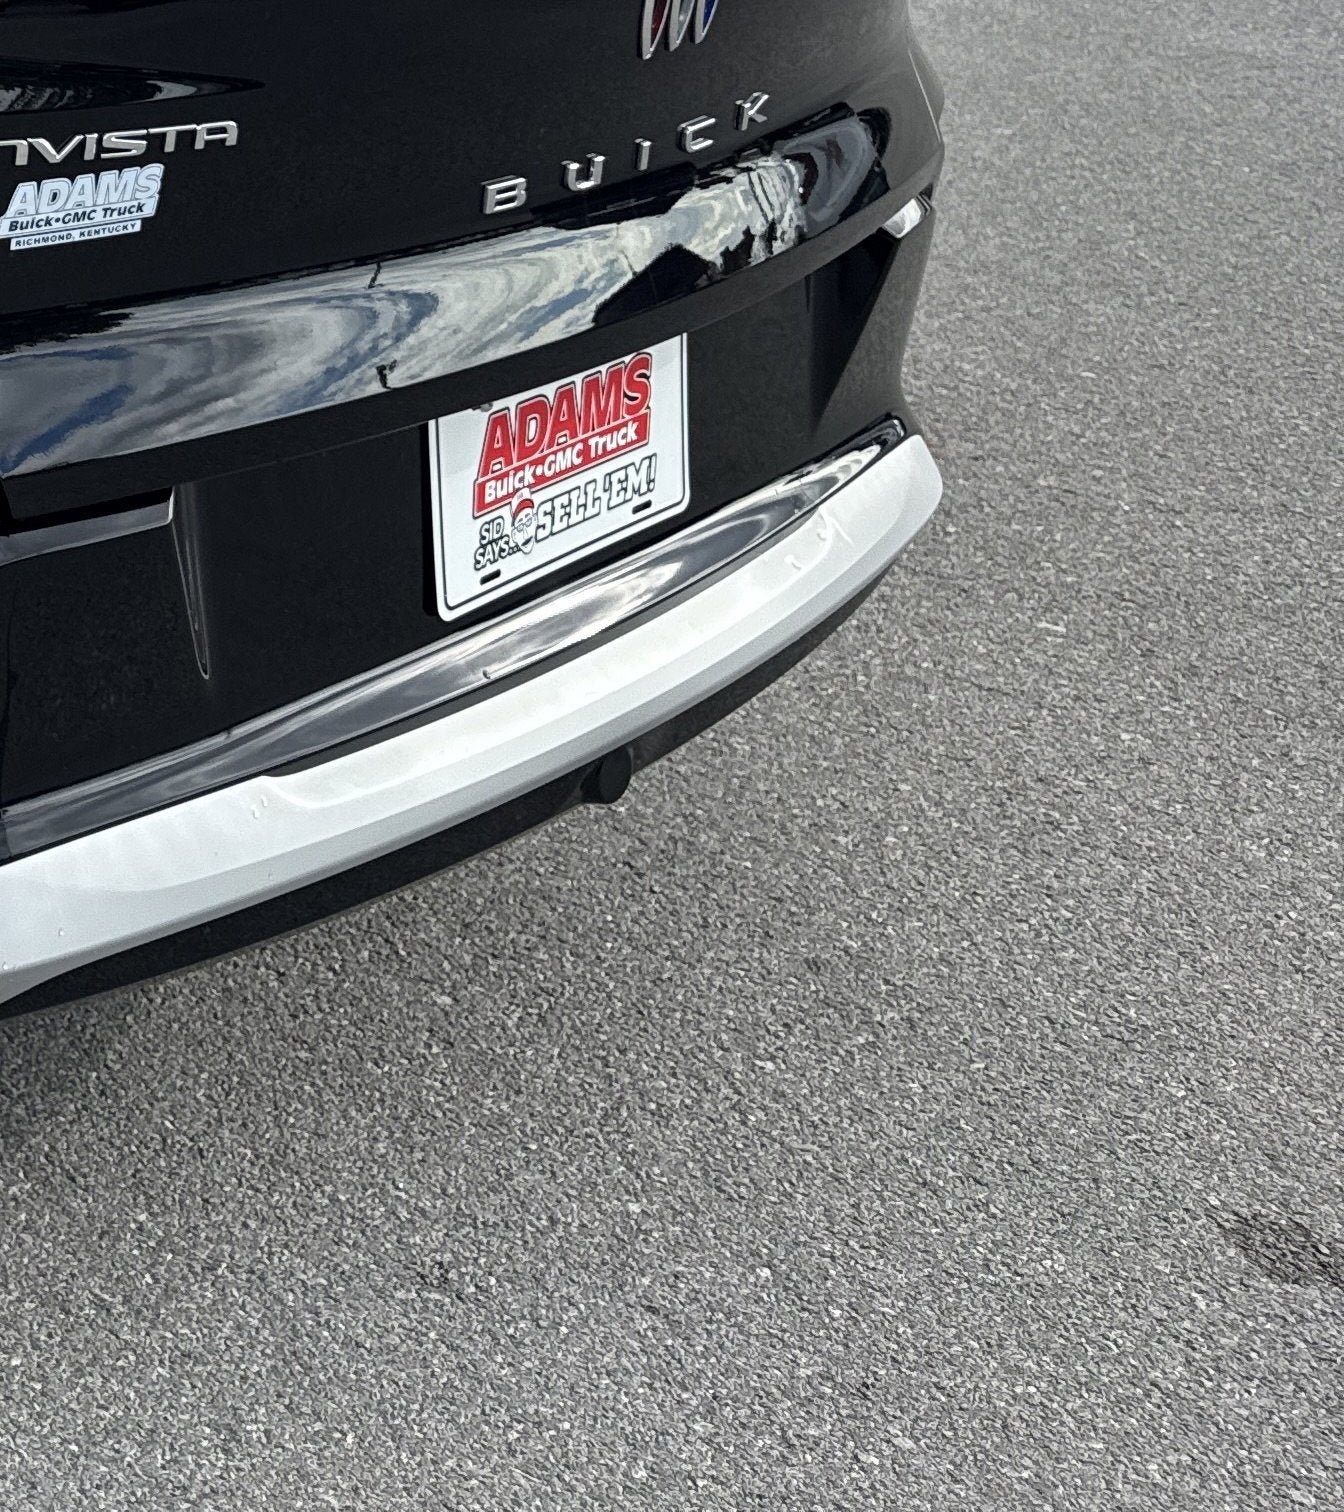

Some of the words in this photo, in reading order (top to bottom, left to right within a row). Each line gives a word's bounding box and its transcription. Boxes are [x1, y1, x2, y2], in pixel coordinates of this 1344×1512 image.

[482, 92, 769, 215] BUICK
[12, 164, 164, 218] ADAMS
[102, 202, 147, 219] Truck
[79, 222, 137, 239] KENTUCKY
[478, 353, 653, 480] ADAMS
[588, 420, 639, 460] Truck
[480, 515, 505, 545] SID
